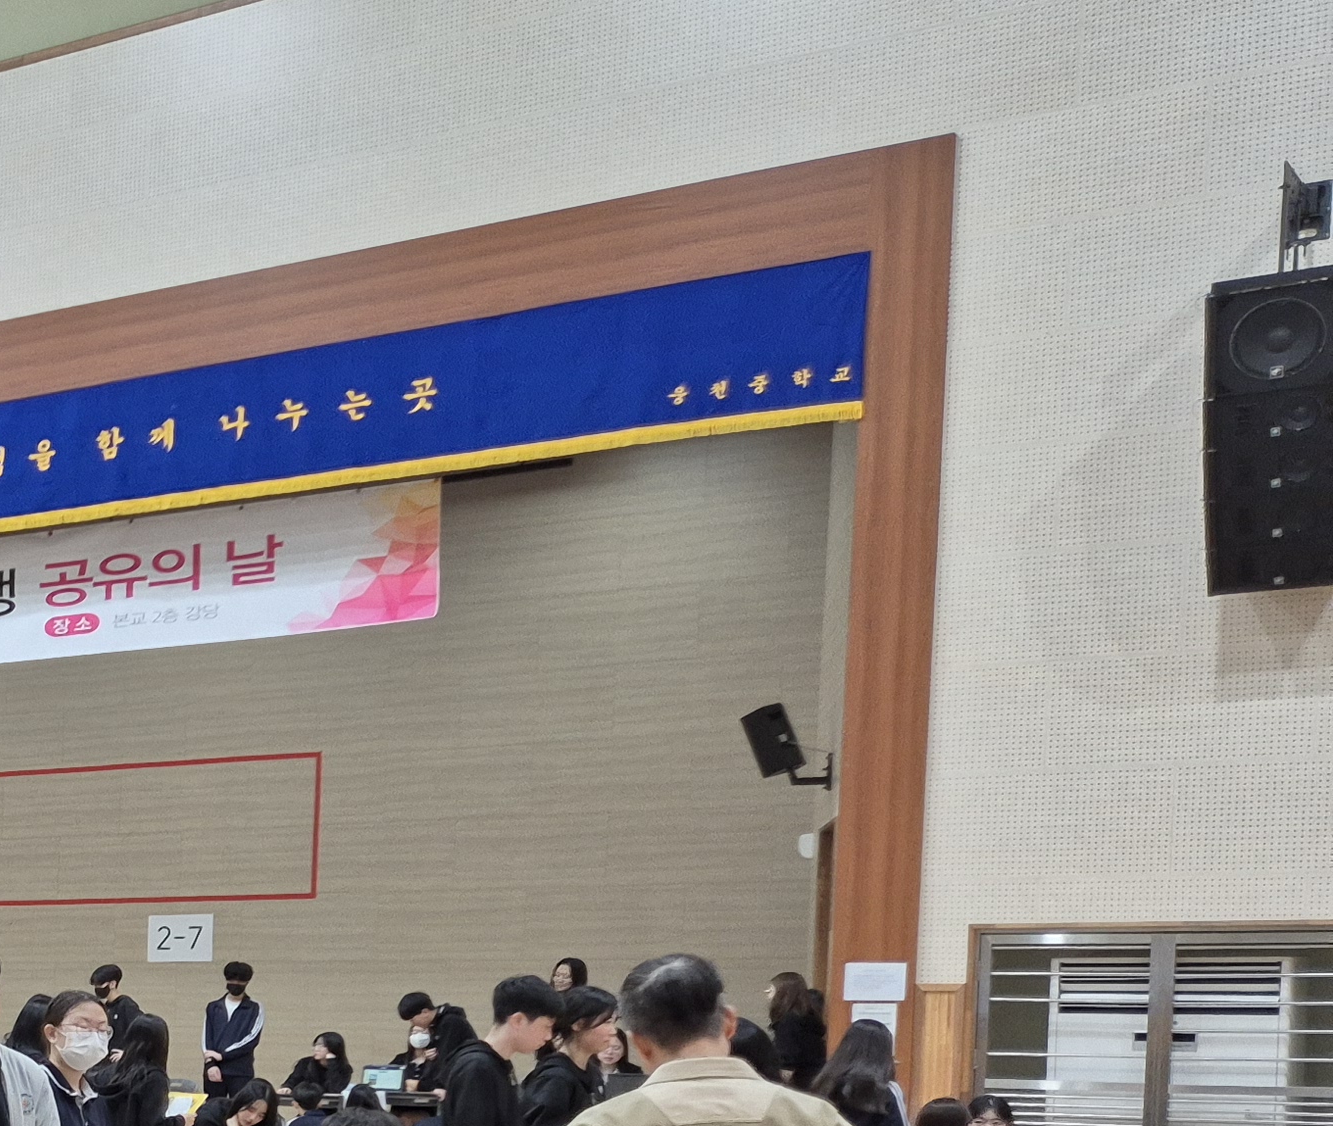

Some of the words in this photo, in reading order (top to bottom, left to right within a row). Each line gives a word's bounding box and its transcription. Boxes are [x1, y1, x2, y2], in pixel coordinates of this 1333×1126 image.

[96, 417, 175, 462] 함께
[219, 388, 373, 442] 나누는
[402, 375, 438, 415] 곳
[38, 542, 202, 608] 공유의
[226, 533, 285, 587] 날
[53, 616, 93, 636] 장소
[112, 610, 148, 629] 본교
[151, 606, 179, 625] 2층
[185, 602, 220, 622] 강당
[156, 925, 203, 951] 2-7
